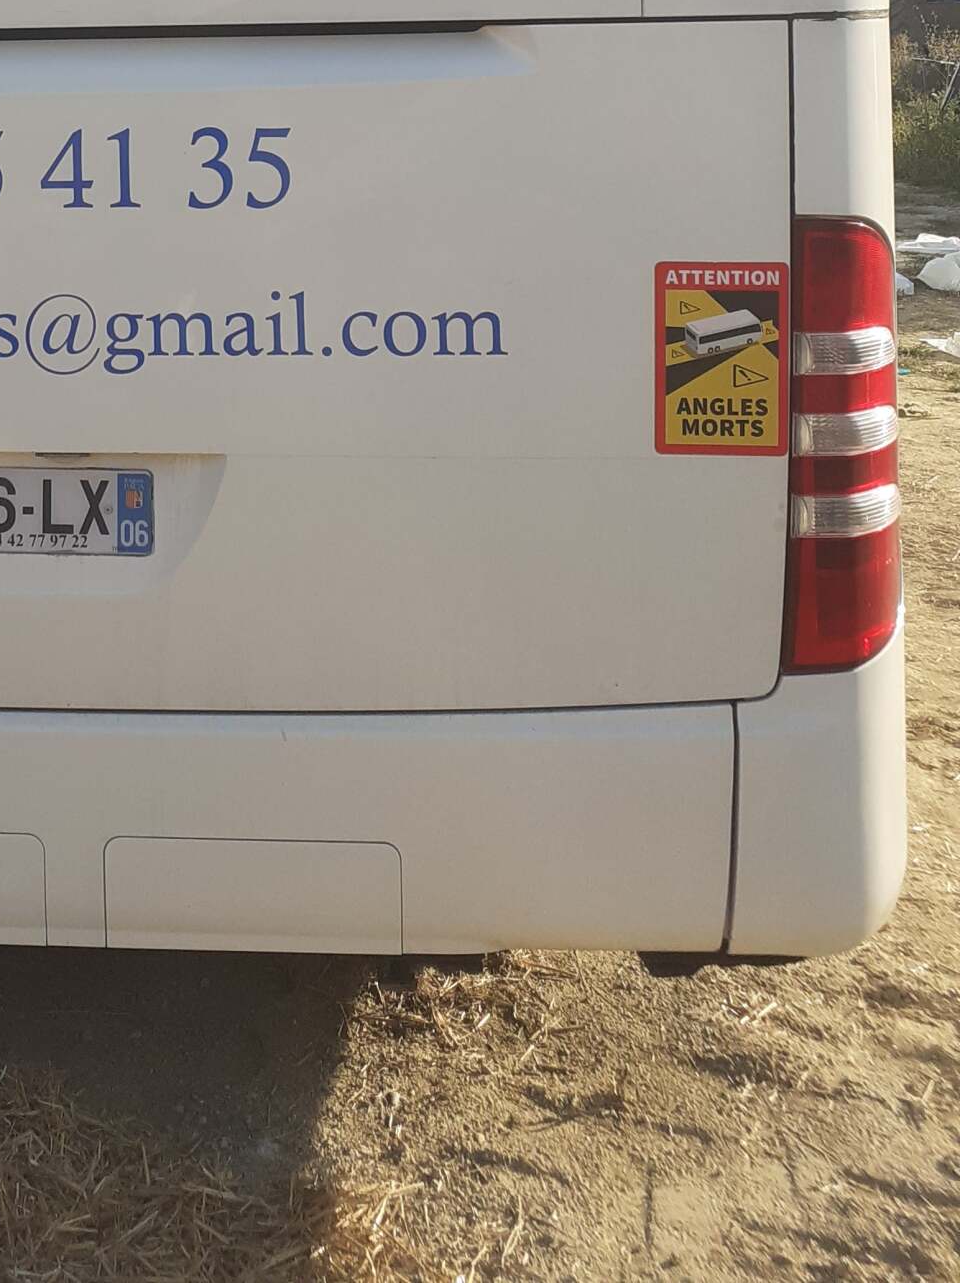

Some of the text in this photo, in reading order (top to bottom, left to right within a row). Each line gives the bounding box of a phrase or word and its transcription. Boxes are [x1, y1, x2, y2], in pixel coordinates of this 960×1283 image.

[42, 131, 142, 209] 41
[189, 127, 293, 208] 35
[665, 269, 781, 287] ATTENTION
[676, 397, 769, 416] ANGLES
[681, 418, 765, 438] MORTS
[7, 533, 24, 548] 42
[29, 534, 49, 548] 77
[50, 534, 68, 548] 97
[70, 534, 88, 550] 22
[120, 519, 149, 548] 06
